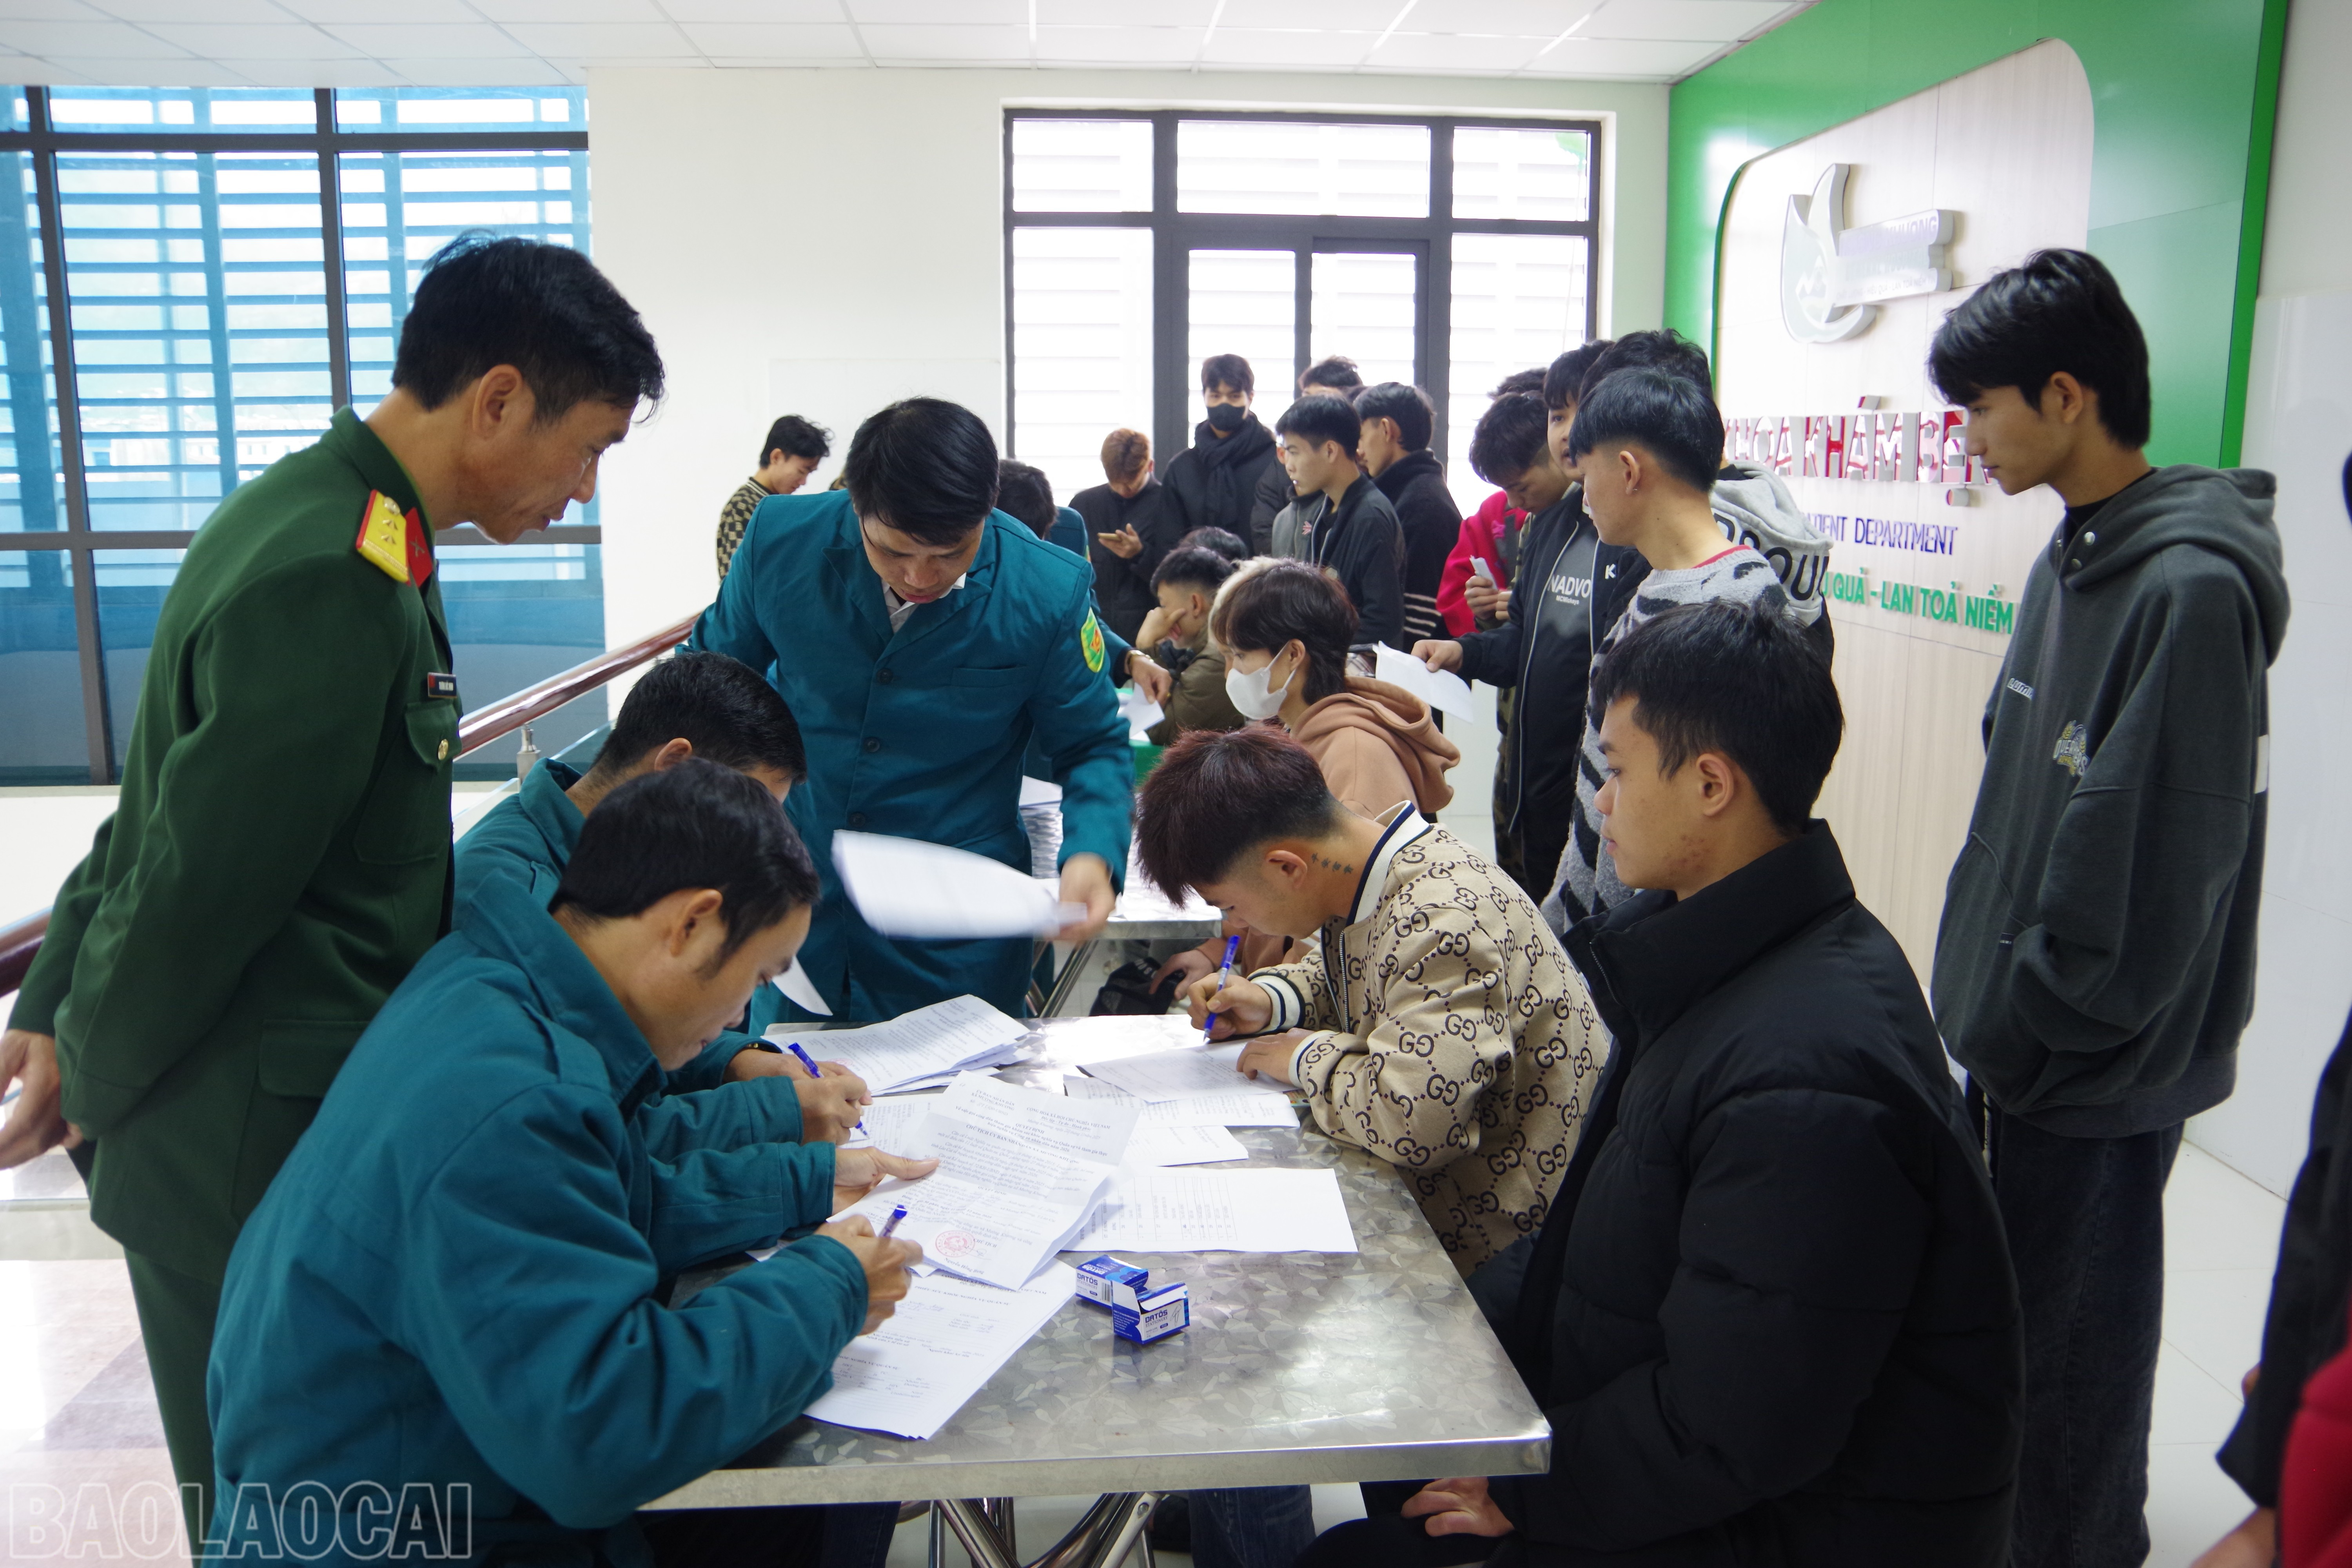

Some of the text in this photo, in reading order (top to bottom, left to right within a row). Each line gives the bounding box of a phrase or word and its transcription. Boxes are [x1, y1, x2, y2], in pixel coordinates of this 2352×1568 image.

[1804, 395, 1904, 481] KHÁM
[1855, 517, 1958, 555] DEPARTMENT
[1833, 567, 1865, 604] QUẢ
[1881, 581, 1913, 614] LAN
[1920, 581, 1958, 623] TOẢ
[1965, 584, 2014, 635] NIỀM
